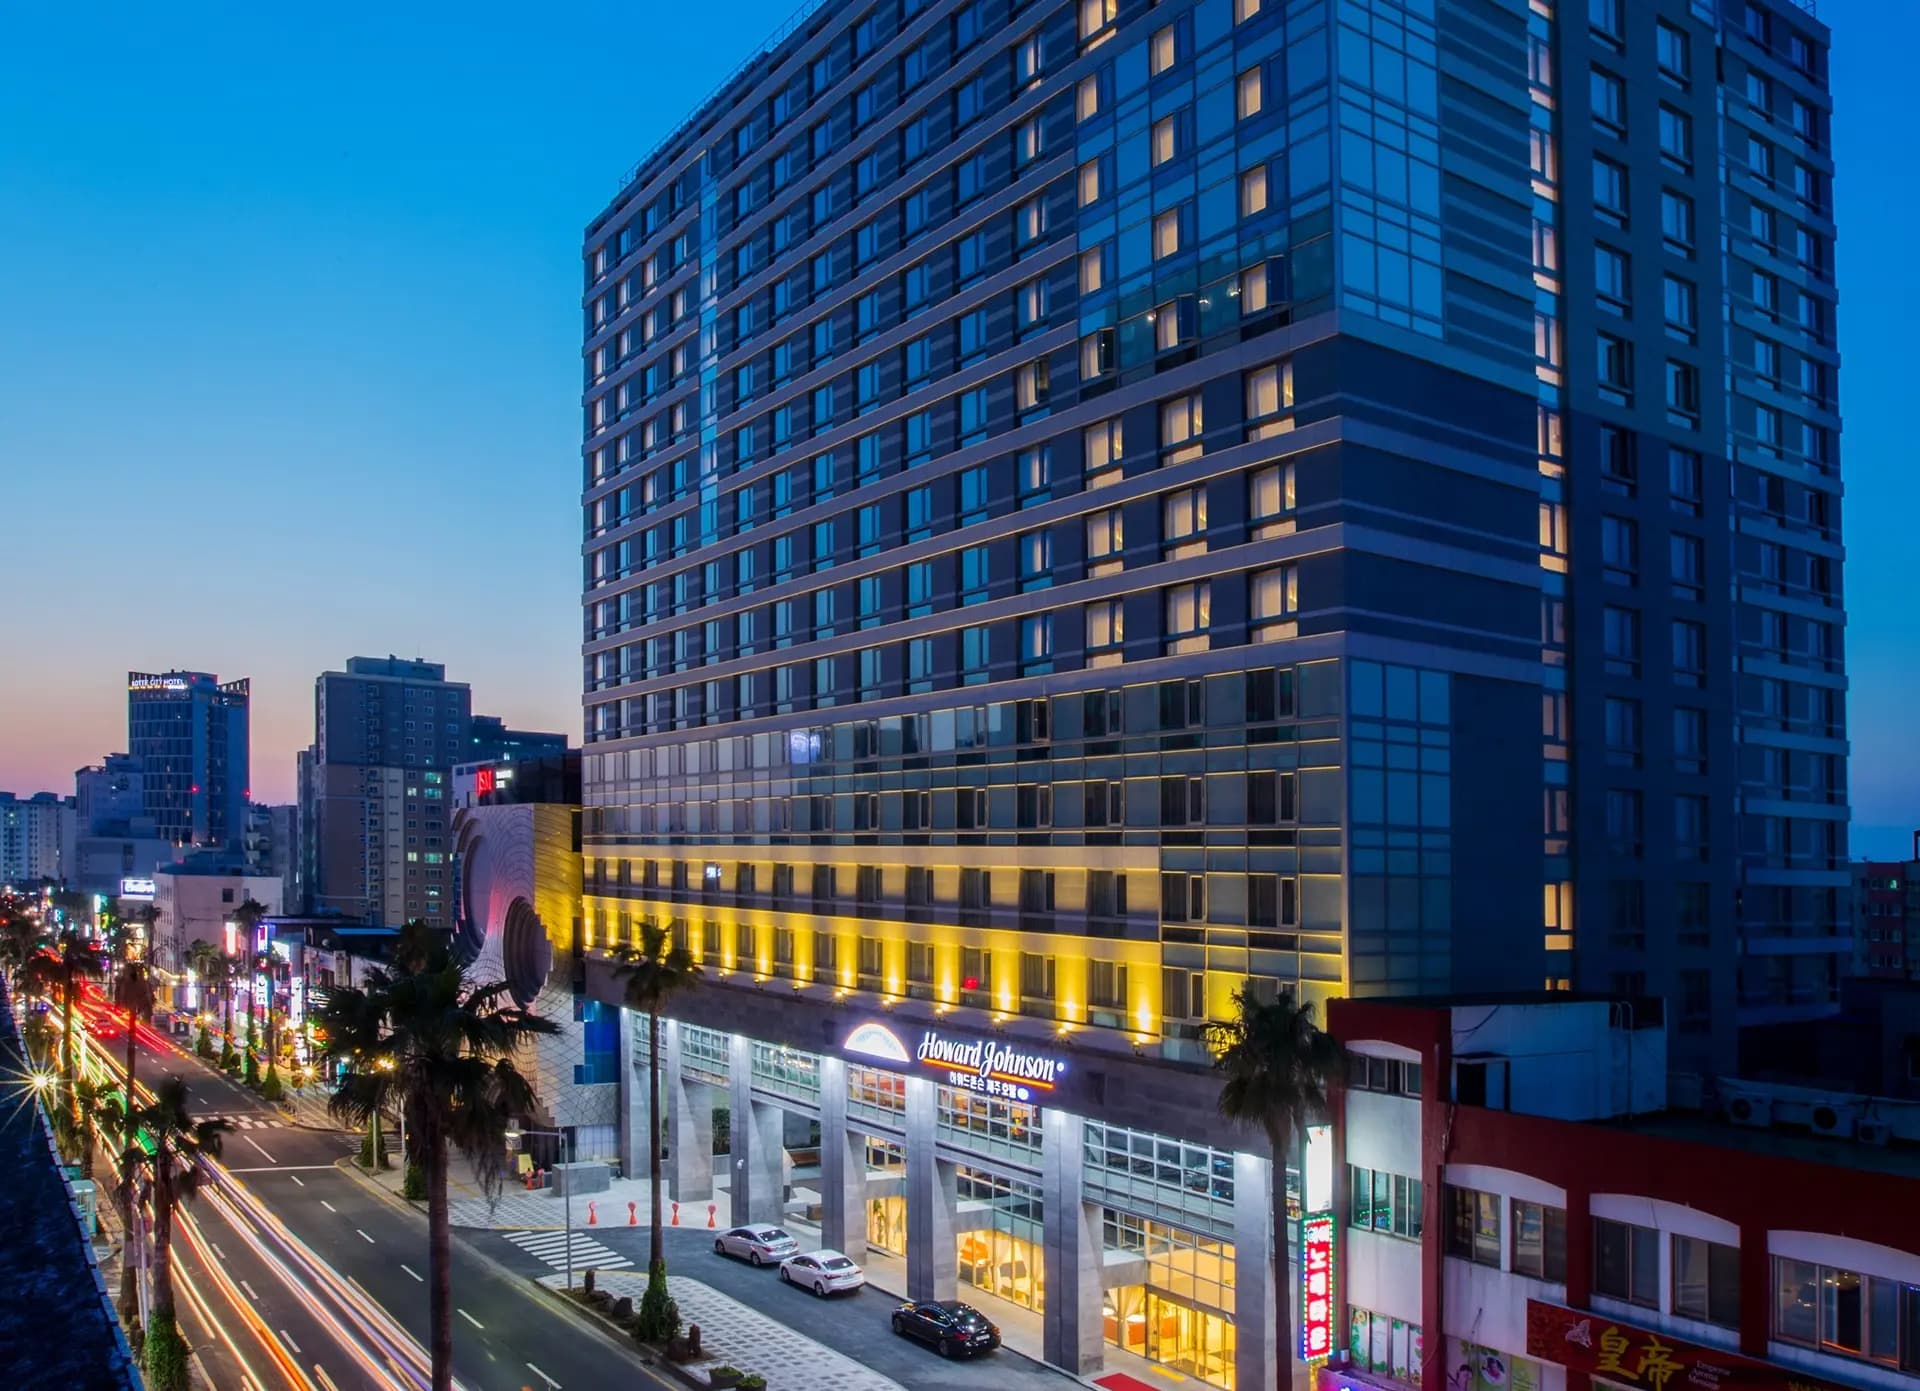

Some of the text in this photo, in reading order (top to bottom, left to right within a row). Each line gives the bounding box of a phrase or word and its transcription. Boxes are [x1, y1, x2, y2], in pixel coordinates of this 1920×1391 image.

[917, 1031, 983, 1072] Howard
[979, 1041, 1056, 1082] Johnson
[1595, 1325, 1685, 1391] 皇帝
